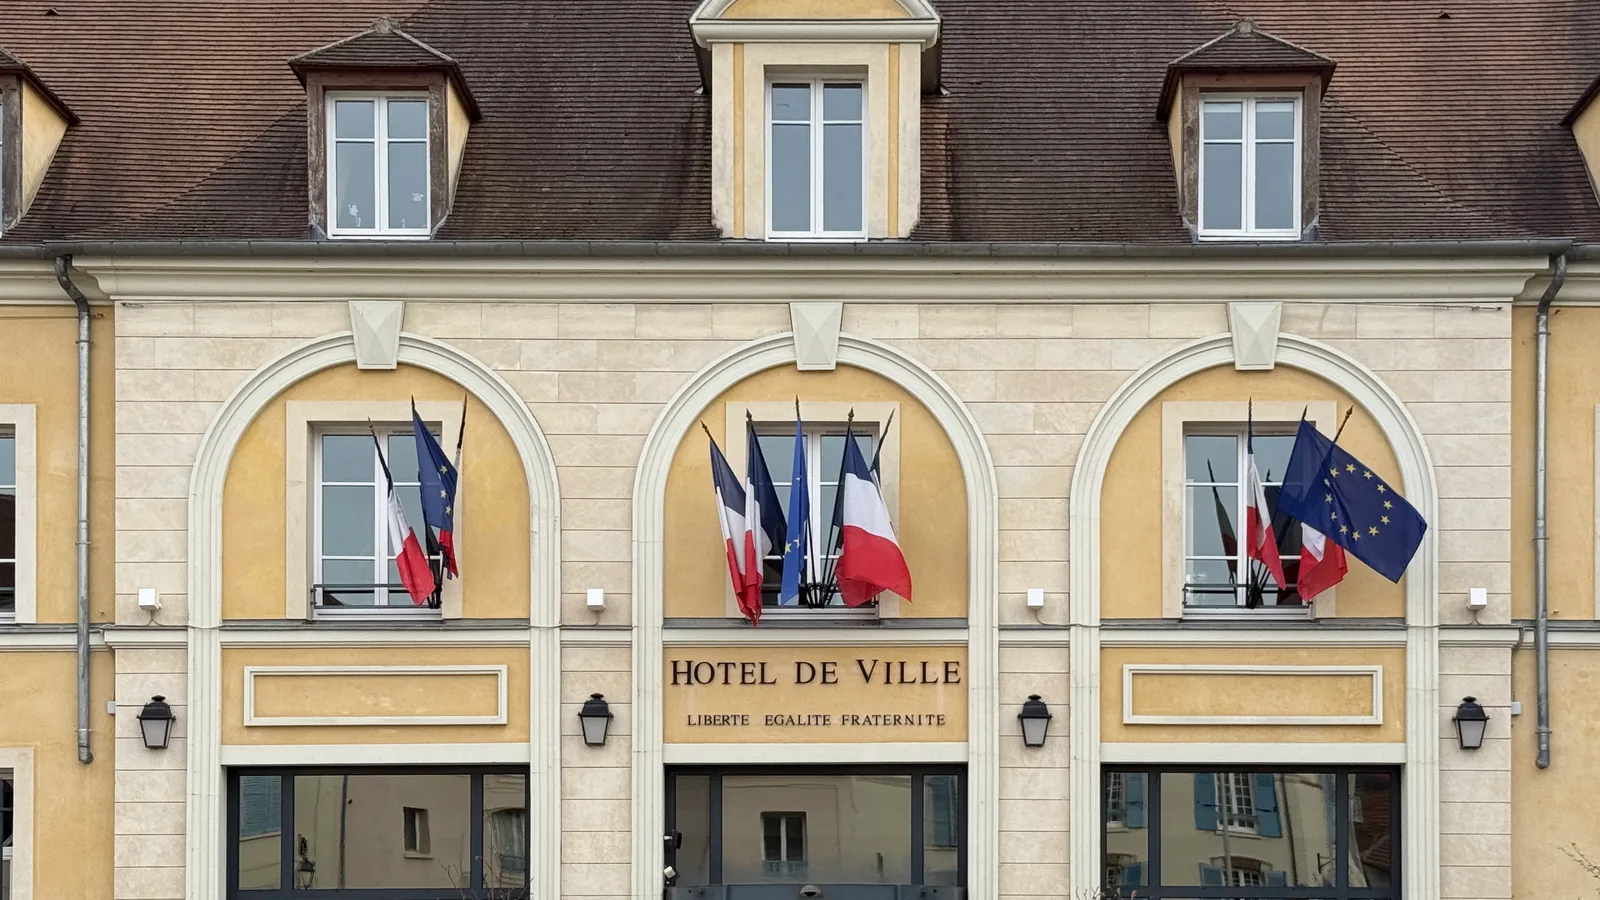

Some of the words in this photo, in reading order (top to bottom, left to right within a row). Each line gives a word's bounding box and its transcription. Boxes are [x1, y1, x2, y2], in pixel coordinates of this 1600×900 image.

[670, 660, 777, 686] HOTEL
[794, 661, 838, 685] DE
[855, 659, 962, 685] VILLE
[687, 714, 750, 726] LIBERTE
[765, 714, 832, 726] EGALITE
[842, 714, 946, 726] FRATERNITE
